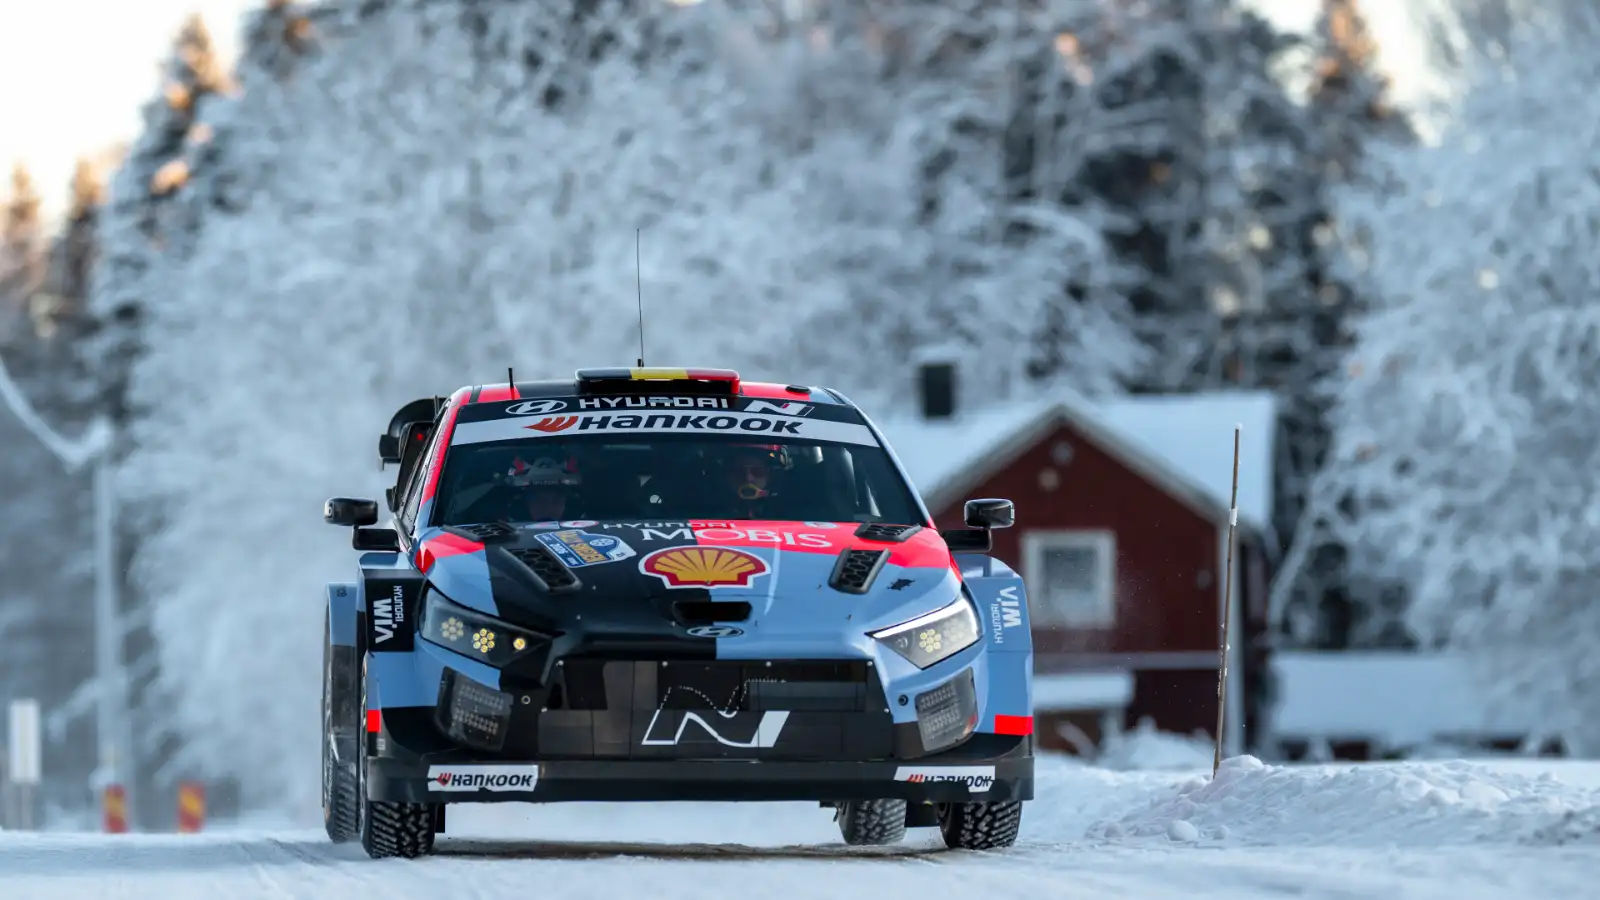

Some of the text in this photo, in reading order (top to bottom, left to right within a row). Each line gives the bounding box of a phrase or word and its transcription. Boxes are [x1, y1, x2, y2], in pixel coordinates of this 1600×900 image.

[579, 396, 729, 409] HYUNDAI
[602, 521, 736, 530] HYUNDAI
[640, 528, 832, 548] MOBIS
[373, 598, 397, 644] WIA
[393, 585, 404, 622] HYUNDAI
[996, 586, 1021, 628] WIA
[991, 603, 1004, 644] HYUNDAI
